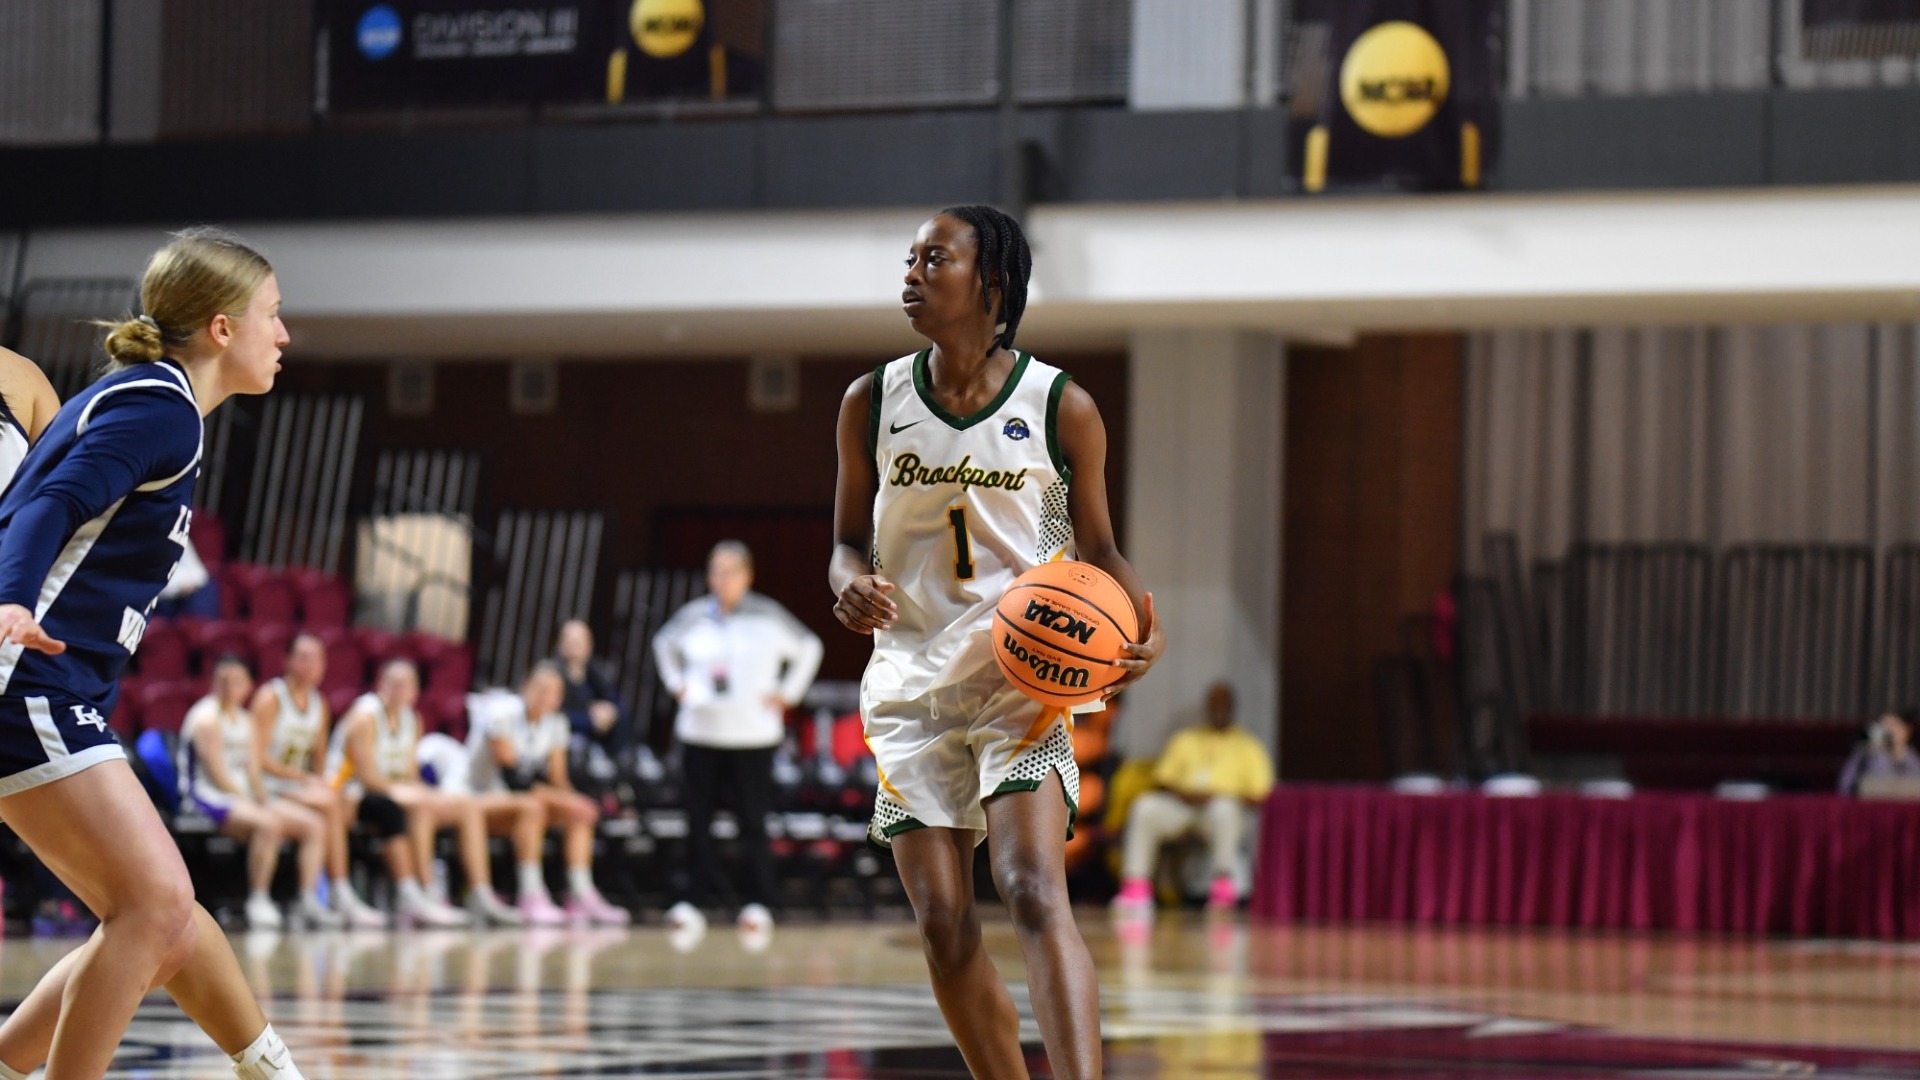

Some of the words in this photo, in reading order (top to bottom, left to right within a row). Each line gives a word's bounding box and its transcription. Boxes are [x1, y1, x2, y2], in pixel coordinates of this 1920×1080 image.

[890, 452, 1027, 492] Brockport
[946, 505, 976, 582] 1
[1024, 599, 1096, 645] NCAA
[1003, 633, 1089, 688] Wilson
[1032, 648, 1045, 656] NXT
